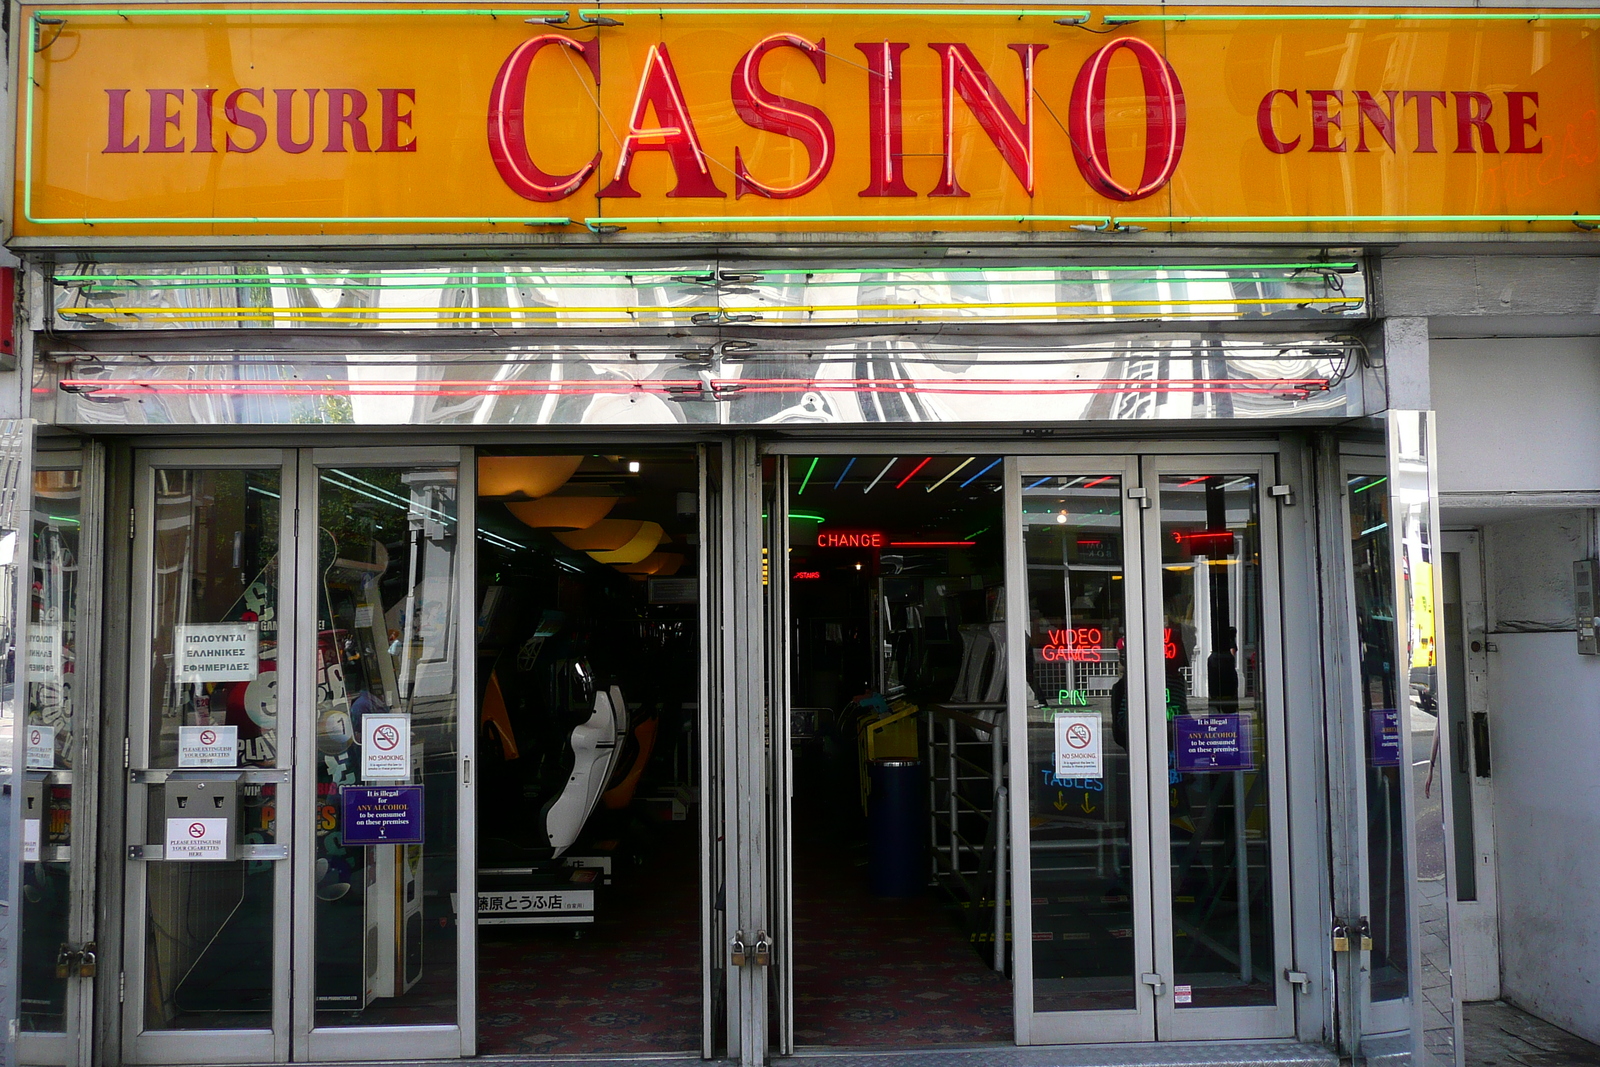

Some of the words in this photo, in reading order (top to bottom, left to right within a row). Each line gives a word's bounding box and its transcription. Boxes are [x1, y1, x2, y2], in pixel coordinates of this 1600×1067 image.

[102, 88, 417, 154] LEISURE
[487, 32, 1187, 202] CASINO
[1257, 88, 1544, 155] CENTRE
[817, 533, 881, 548] CHANGE
[185, 634, 246, 643] ΠΩΛΟΥΝΤΑΙ
[1048, 628, 1102, 645] VIDEO
[186, 649, 246, 657] ΕΛΛΗΝΙΚΕΣ
[1042, 644, 1102, 662] GAMES
[183, 663, 249, 672] ΕΦΗΜΕΡΙΔΕΣ
[1058, 689, 1087, 706] PIN
[1209, 718, 1228, 726] illegal
[1213, 746, 1239, 754] premises
[380, 790, 399, 798] illegal
[382, 818, 409, 827] premises
